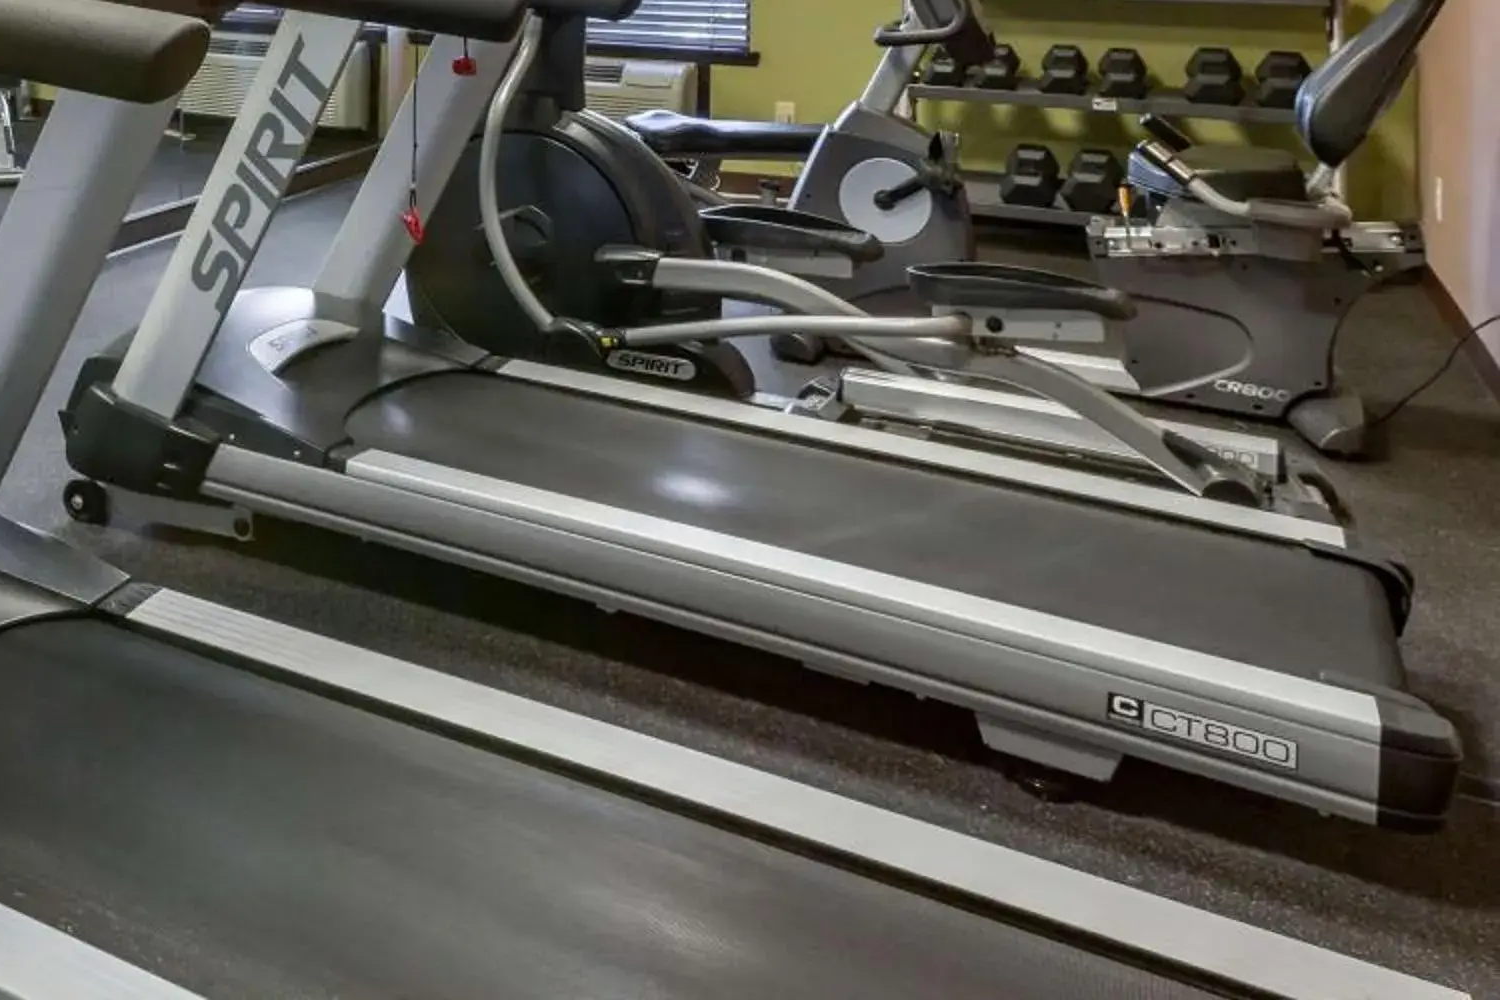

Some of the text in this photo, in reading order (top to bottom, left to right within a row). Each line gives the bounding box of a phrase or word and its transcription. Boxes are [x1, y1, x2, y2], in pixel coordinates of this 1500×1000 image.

[191, 34, 330, 320] SPIRIT
[619, 353, 682, 375] SPIRIT
[1151, 708, 1290, 763] CT800
